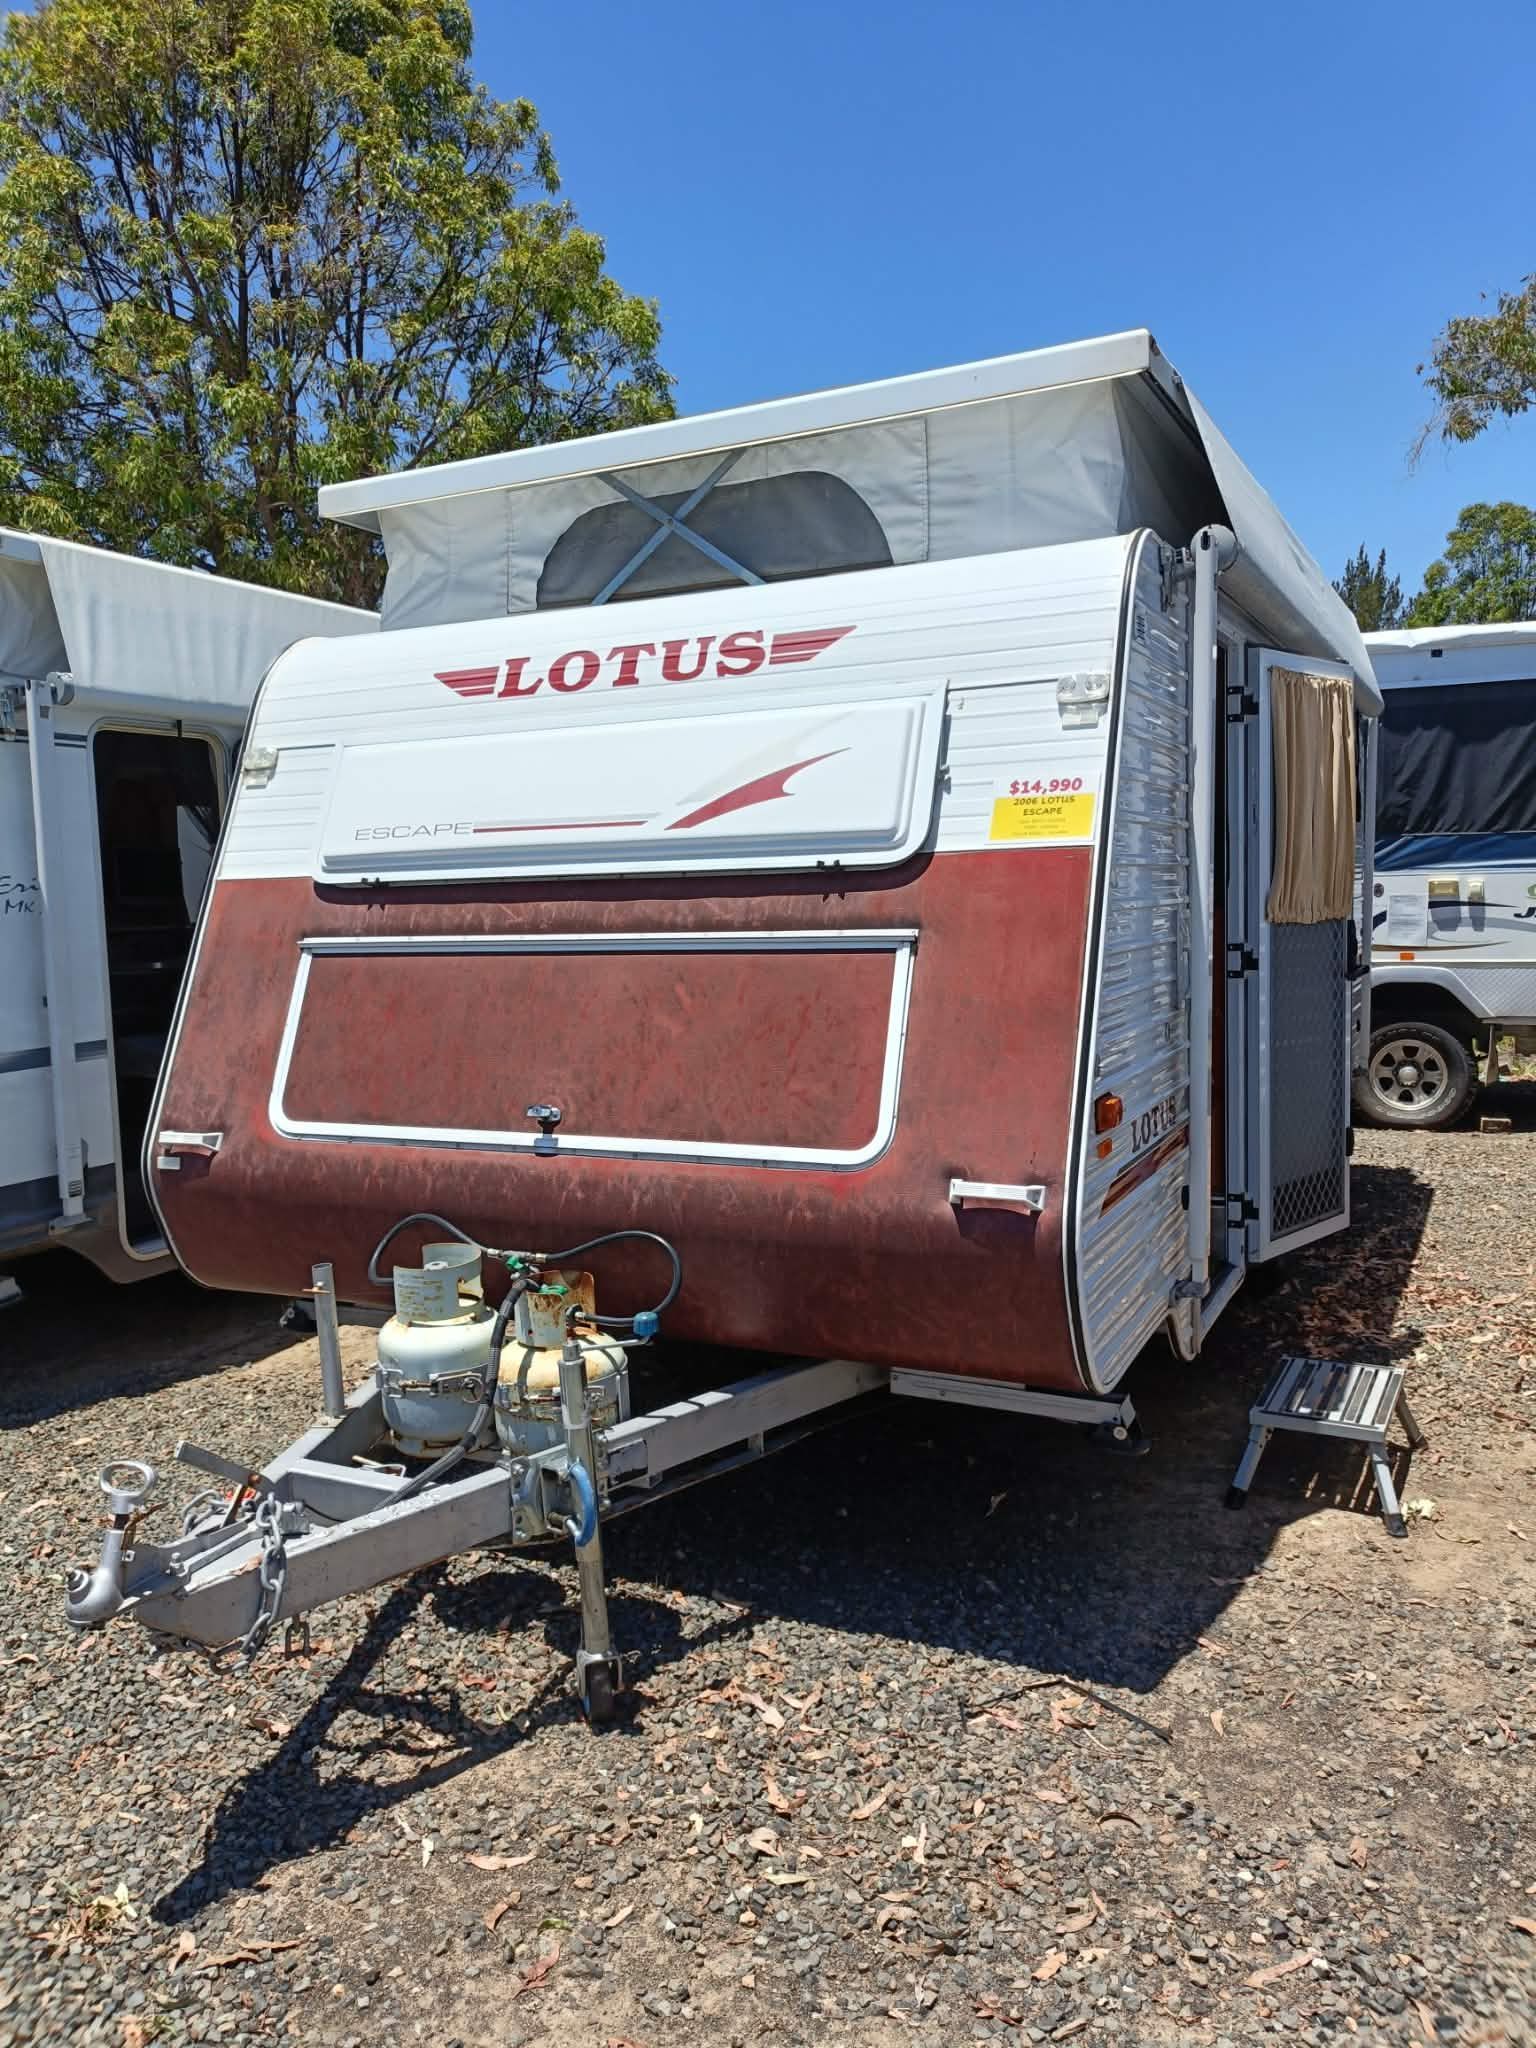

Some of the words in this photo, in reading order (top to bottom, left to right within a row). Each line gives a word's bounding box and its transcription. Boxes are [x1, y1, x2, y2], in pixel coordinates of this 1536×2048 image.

[497, 630, 766, 698] LOTUS
[1009, 777, 1083, 795] $14,990
[1013, 798, 1038, 806] 2006
[1041, 795, 1076, 805] LOTUS
[1023, 807, 1063, 816] ESCAPE
[354, 822, 473, 841] ESCAPE
[1131, 1095, 1178, 1154] LOTUS
